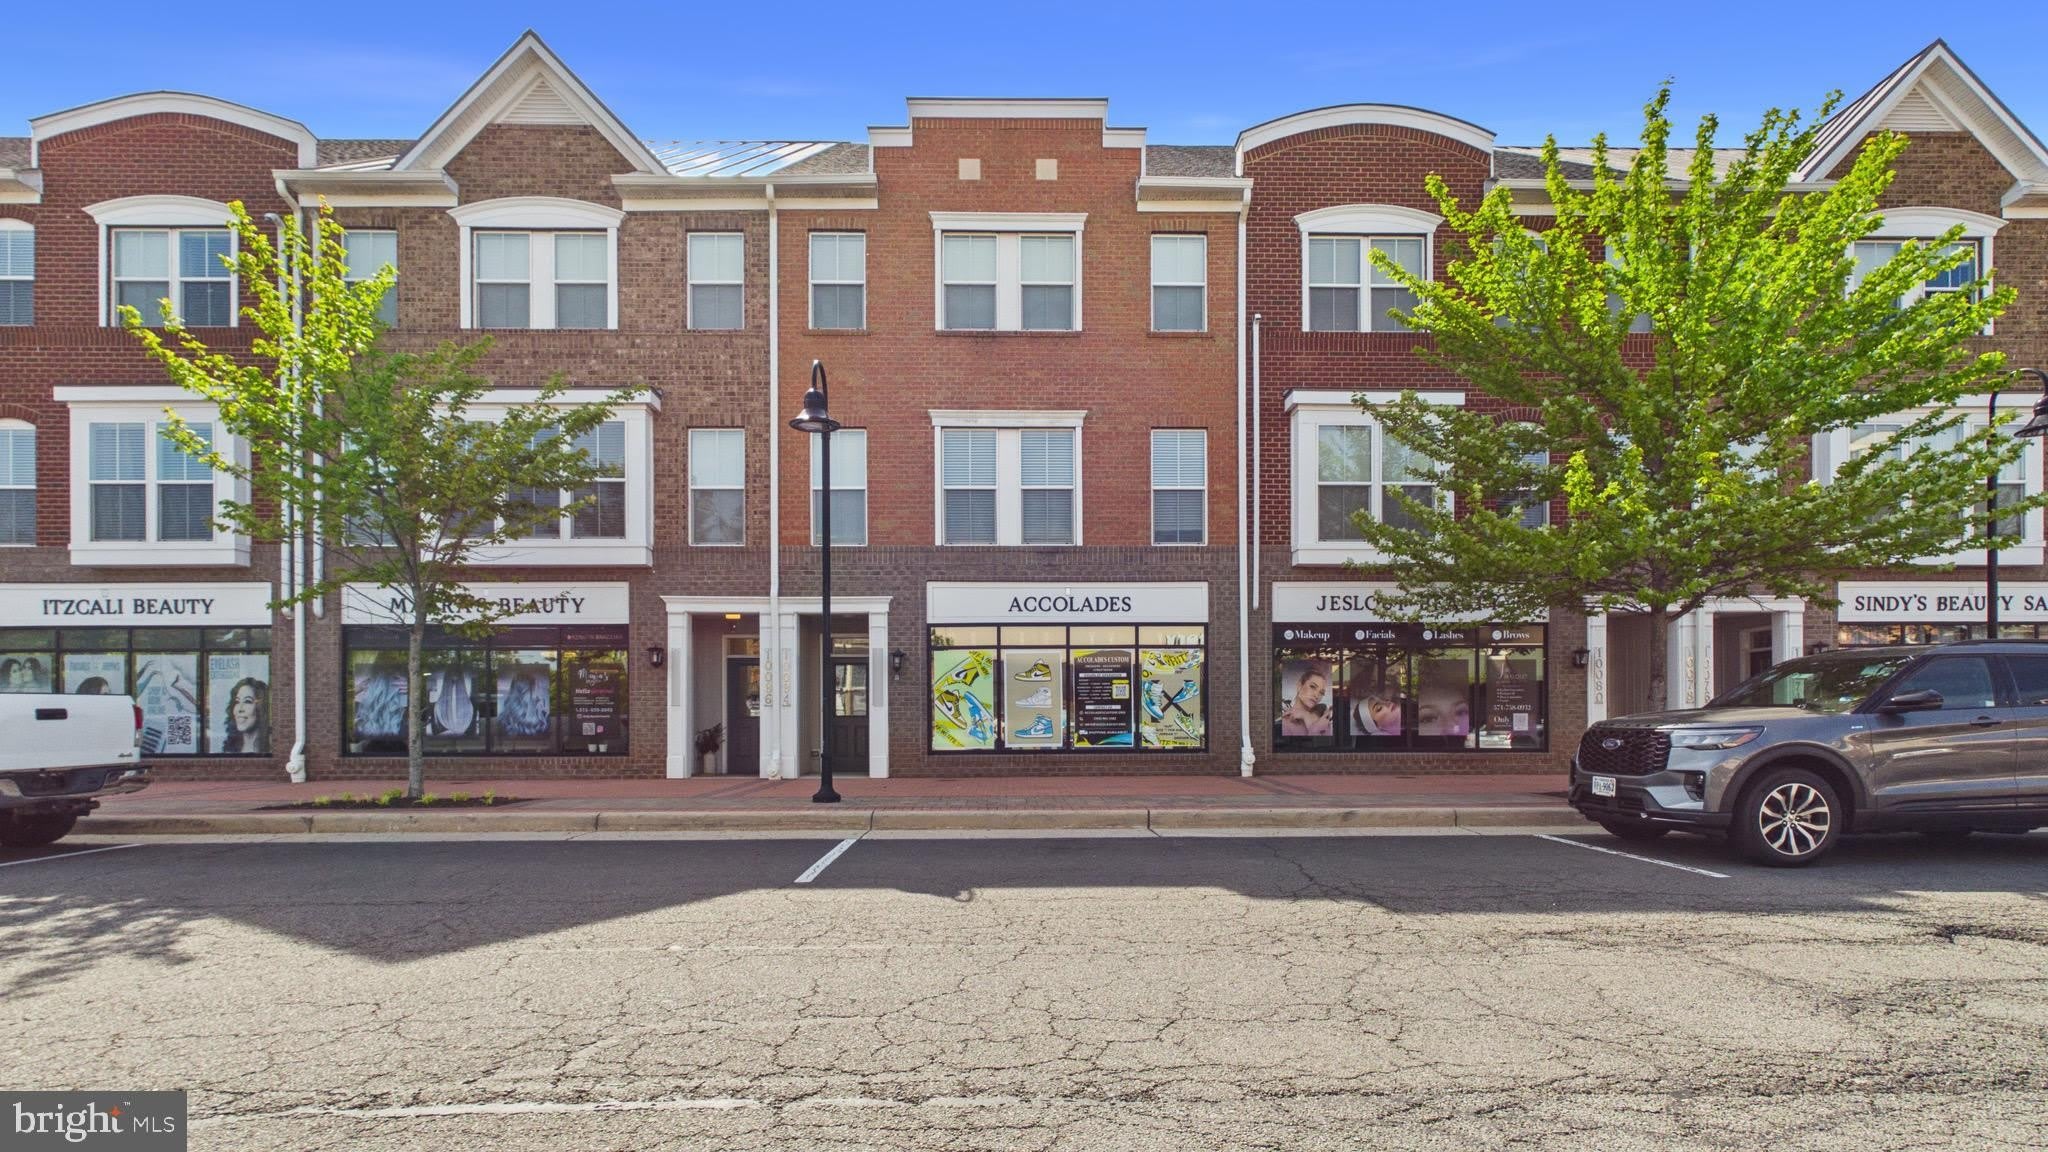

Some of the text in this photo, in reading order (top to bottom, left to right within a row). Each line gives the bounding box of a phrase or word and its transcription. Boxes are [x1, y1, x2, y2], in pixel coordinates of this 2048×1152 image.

[43, 598, 215, 615] ITZCALI BEAUTY
[499, 597, 585, 613] BEAUTY
[1008, 596, 1132, 612] ACCOLADES
[1855, 594, 1927, 612] SINDY'S
[1936, 595, 2014, 612] BEAUY
[1294, 630, 1331, 642] Makeup
[1366, 630, 1396, 640] Facials
[1434, 630, 1464, 640] Lashes
[1503, 630, 1530, 640] Brows
